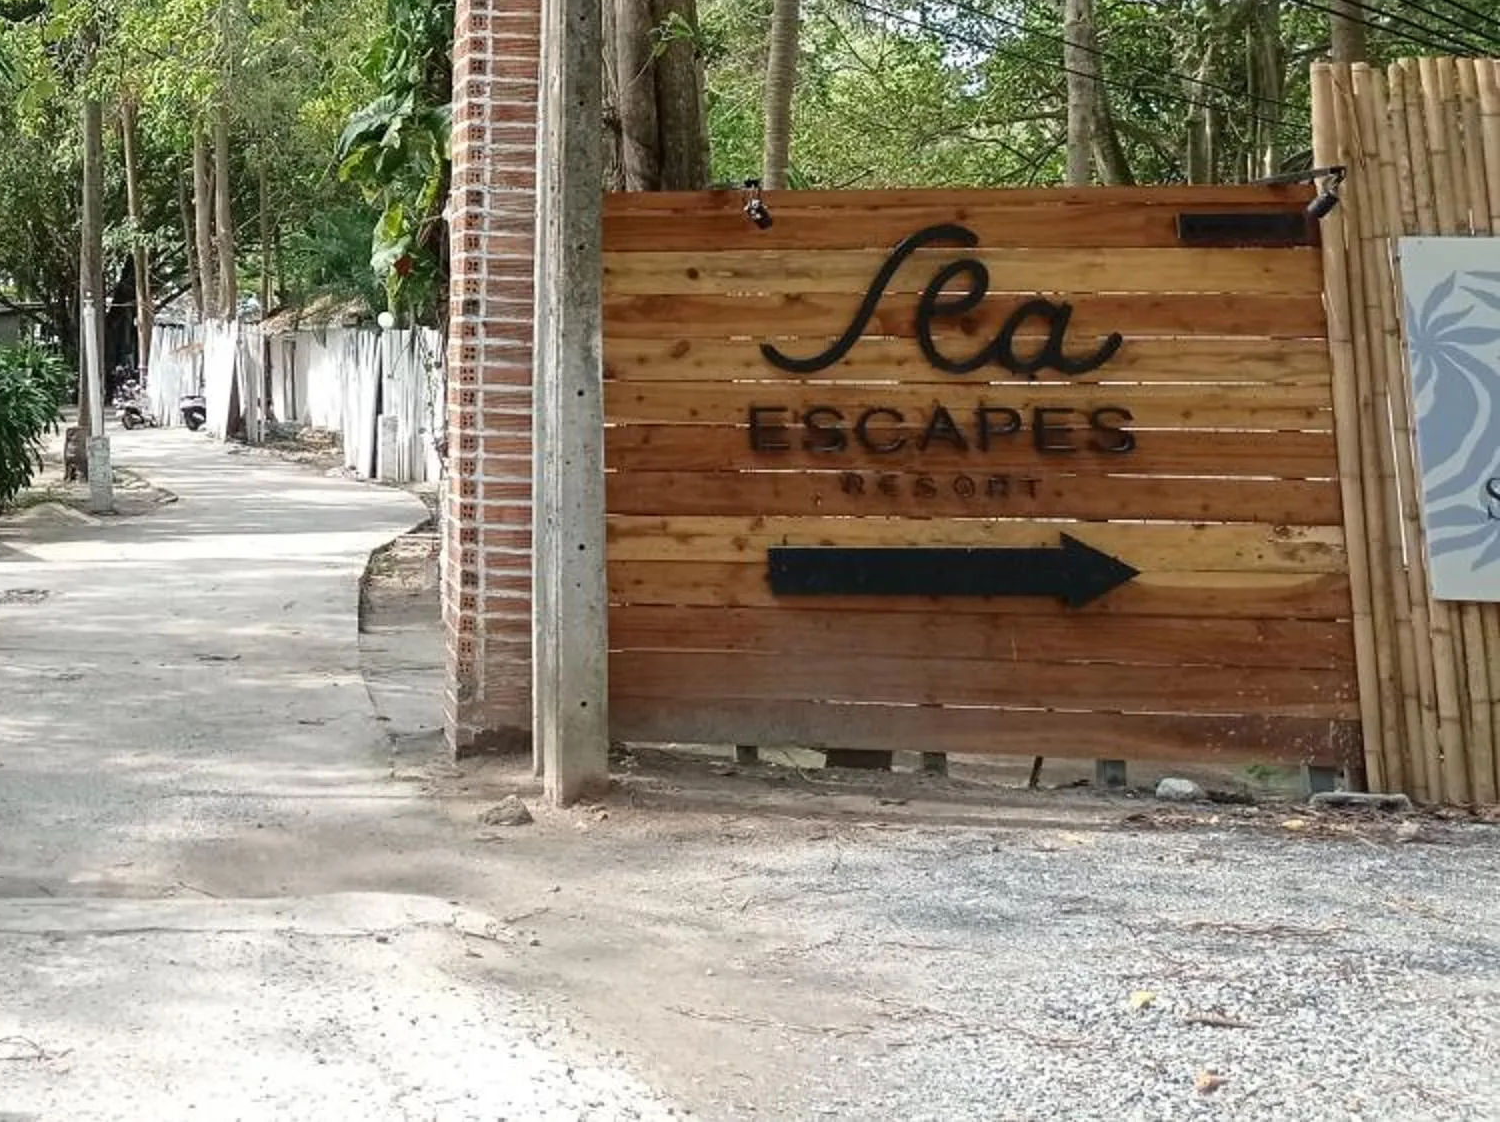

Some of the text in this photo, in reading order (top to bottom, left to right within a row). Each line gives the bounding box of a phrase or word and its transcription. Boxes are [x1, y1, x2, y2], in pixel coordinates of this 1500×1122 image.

[760, 224, 1123, 374] Sea
[747, 404, 1137, 454] ESCAPES
[838, 472, 1043, 499] RESORT
